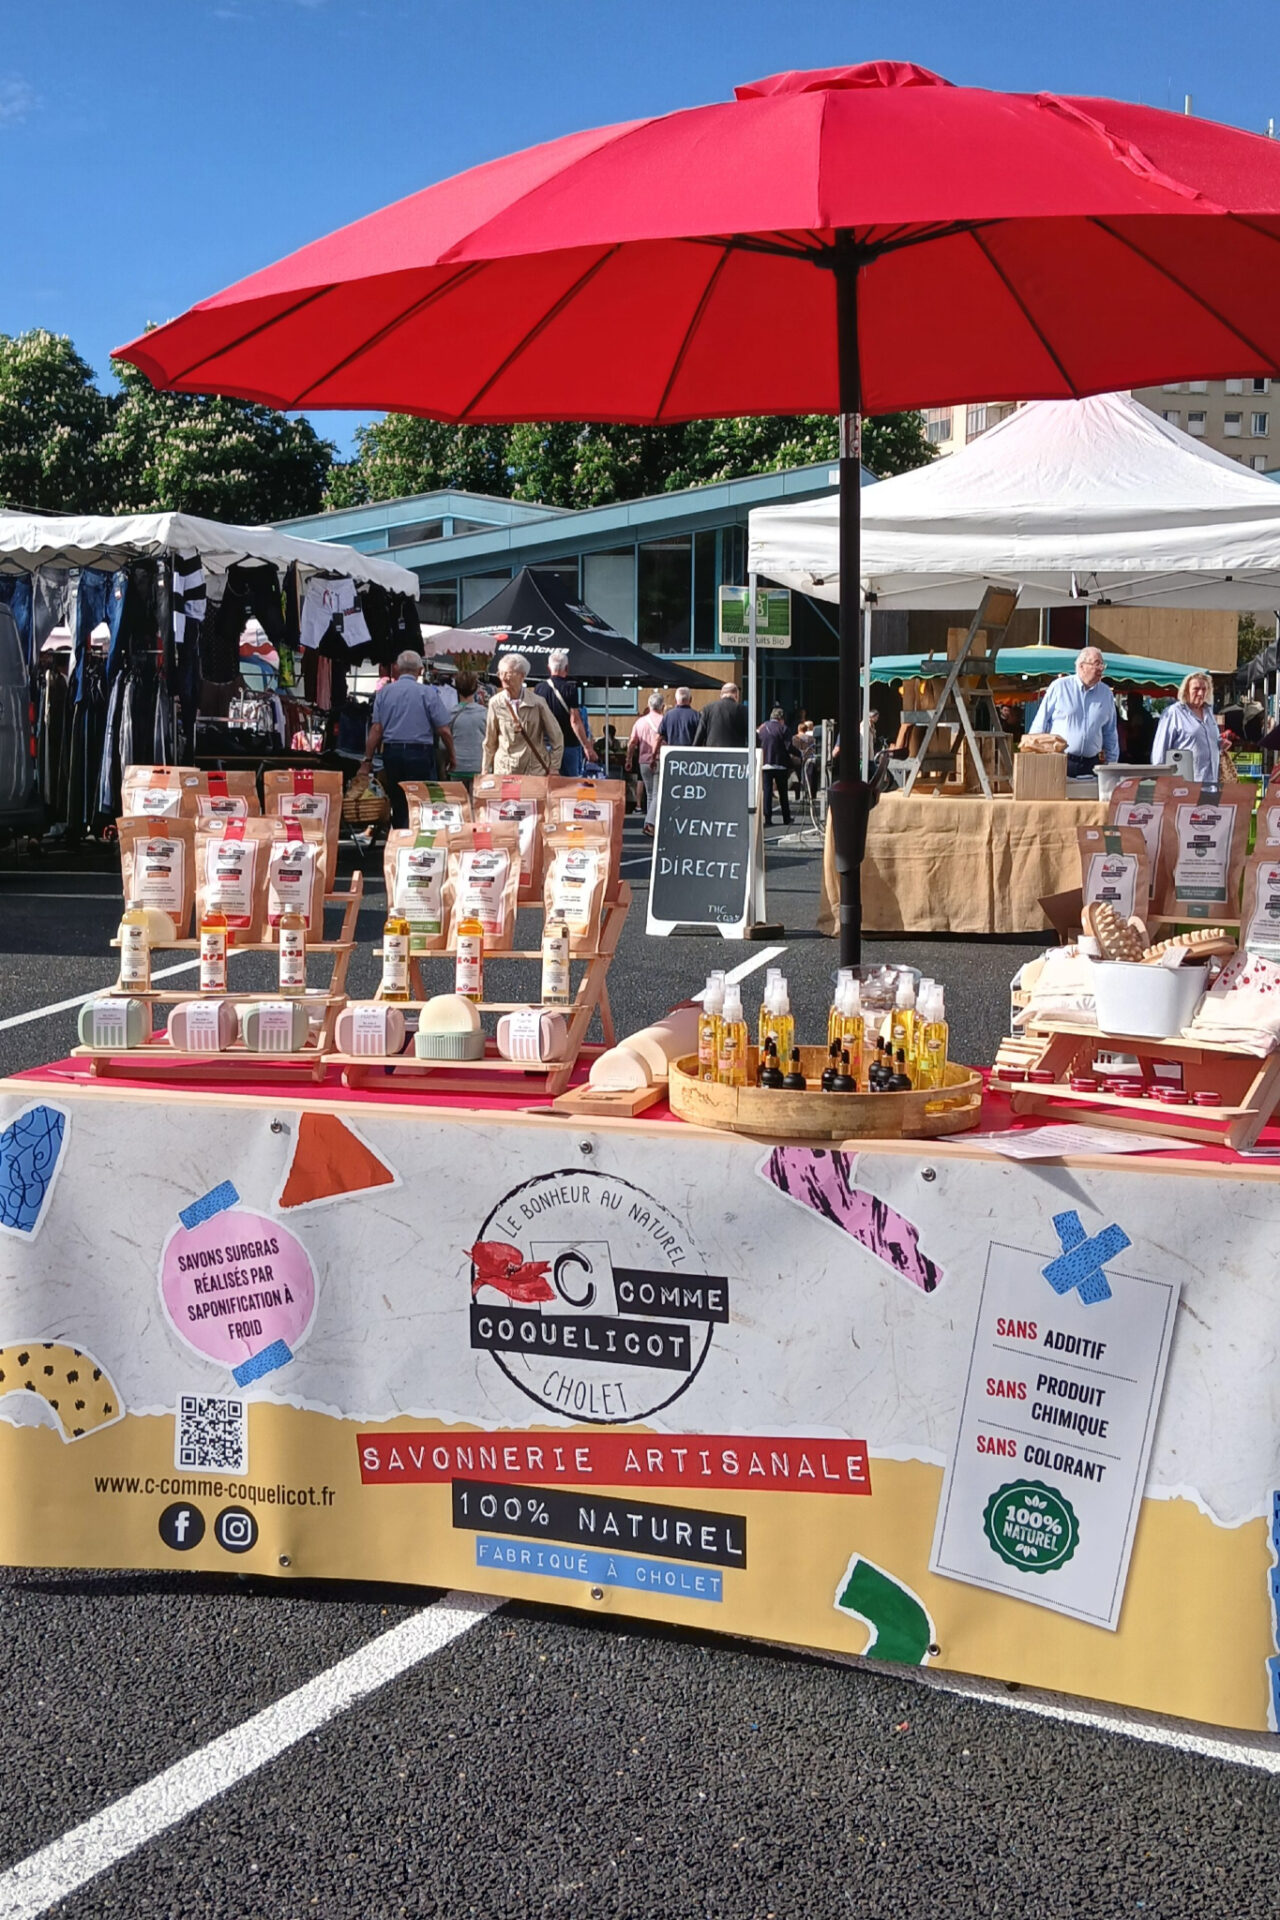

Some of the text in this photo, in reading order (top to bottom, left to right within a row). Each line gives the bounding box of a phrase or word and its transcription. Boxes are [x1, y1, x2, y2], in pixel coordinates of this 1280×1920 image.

[515, 625, 555, 641] 49
[671, 785, 707, 799] CBD
[675, 818, 738, 837] VENTE
[495, 1186, 686, 1268] LE BONHEUR AU NATUREL
[178, 1238, 280, 1272] SAVONS SURGRAS
[193, 1265, 274, 1294] RÉALISÉS PAR
[554, 1247, 723, 1312] C COMME
[187, 1283, 294, 1321] SAPONIFICATION À
[228, 1319, 263, 1340] FROID
[478, 1317, 684, 1358] COQUELICOT
[996, 1318, 1107, 1360] SANS ADDITIF
[543, 1371, 627, 1414] CHOLET
[986, 1374, 1106, 1407] SANS PRODUIT
[1031, 1402, 1109, 1438] CHIMIQUE
[363, 1447, 866, 1482] SAVONNERIE ARTISANALE
[976, 1435, 1106, 1482] SANS COLORANT
[94, 1477, 336, 1506] www.c-comme-coquelicot.fr
[460, 1492, 743, 1555] 100% NATUREL
[1002, 1521, 1058, 1551] NATUREL
[1005, 1505, 1062, 1535] 100%
[479, 1544, 721, 1593] FABRIQUÉ À CHOLET
